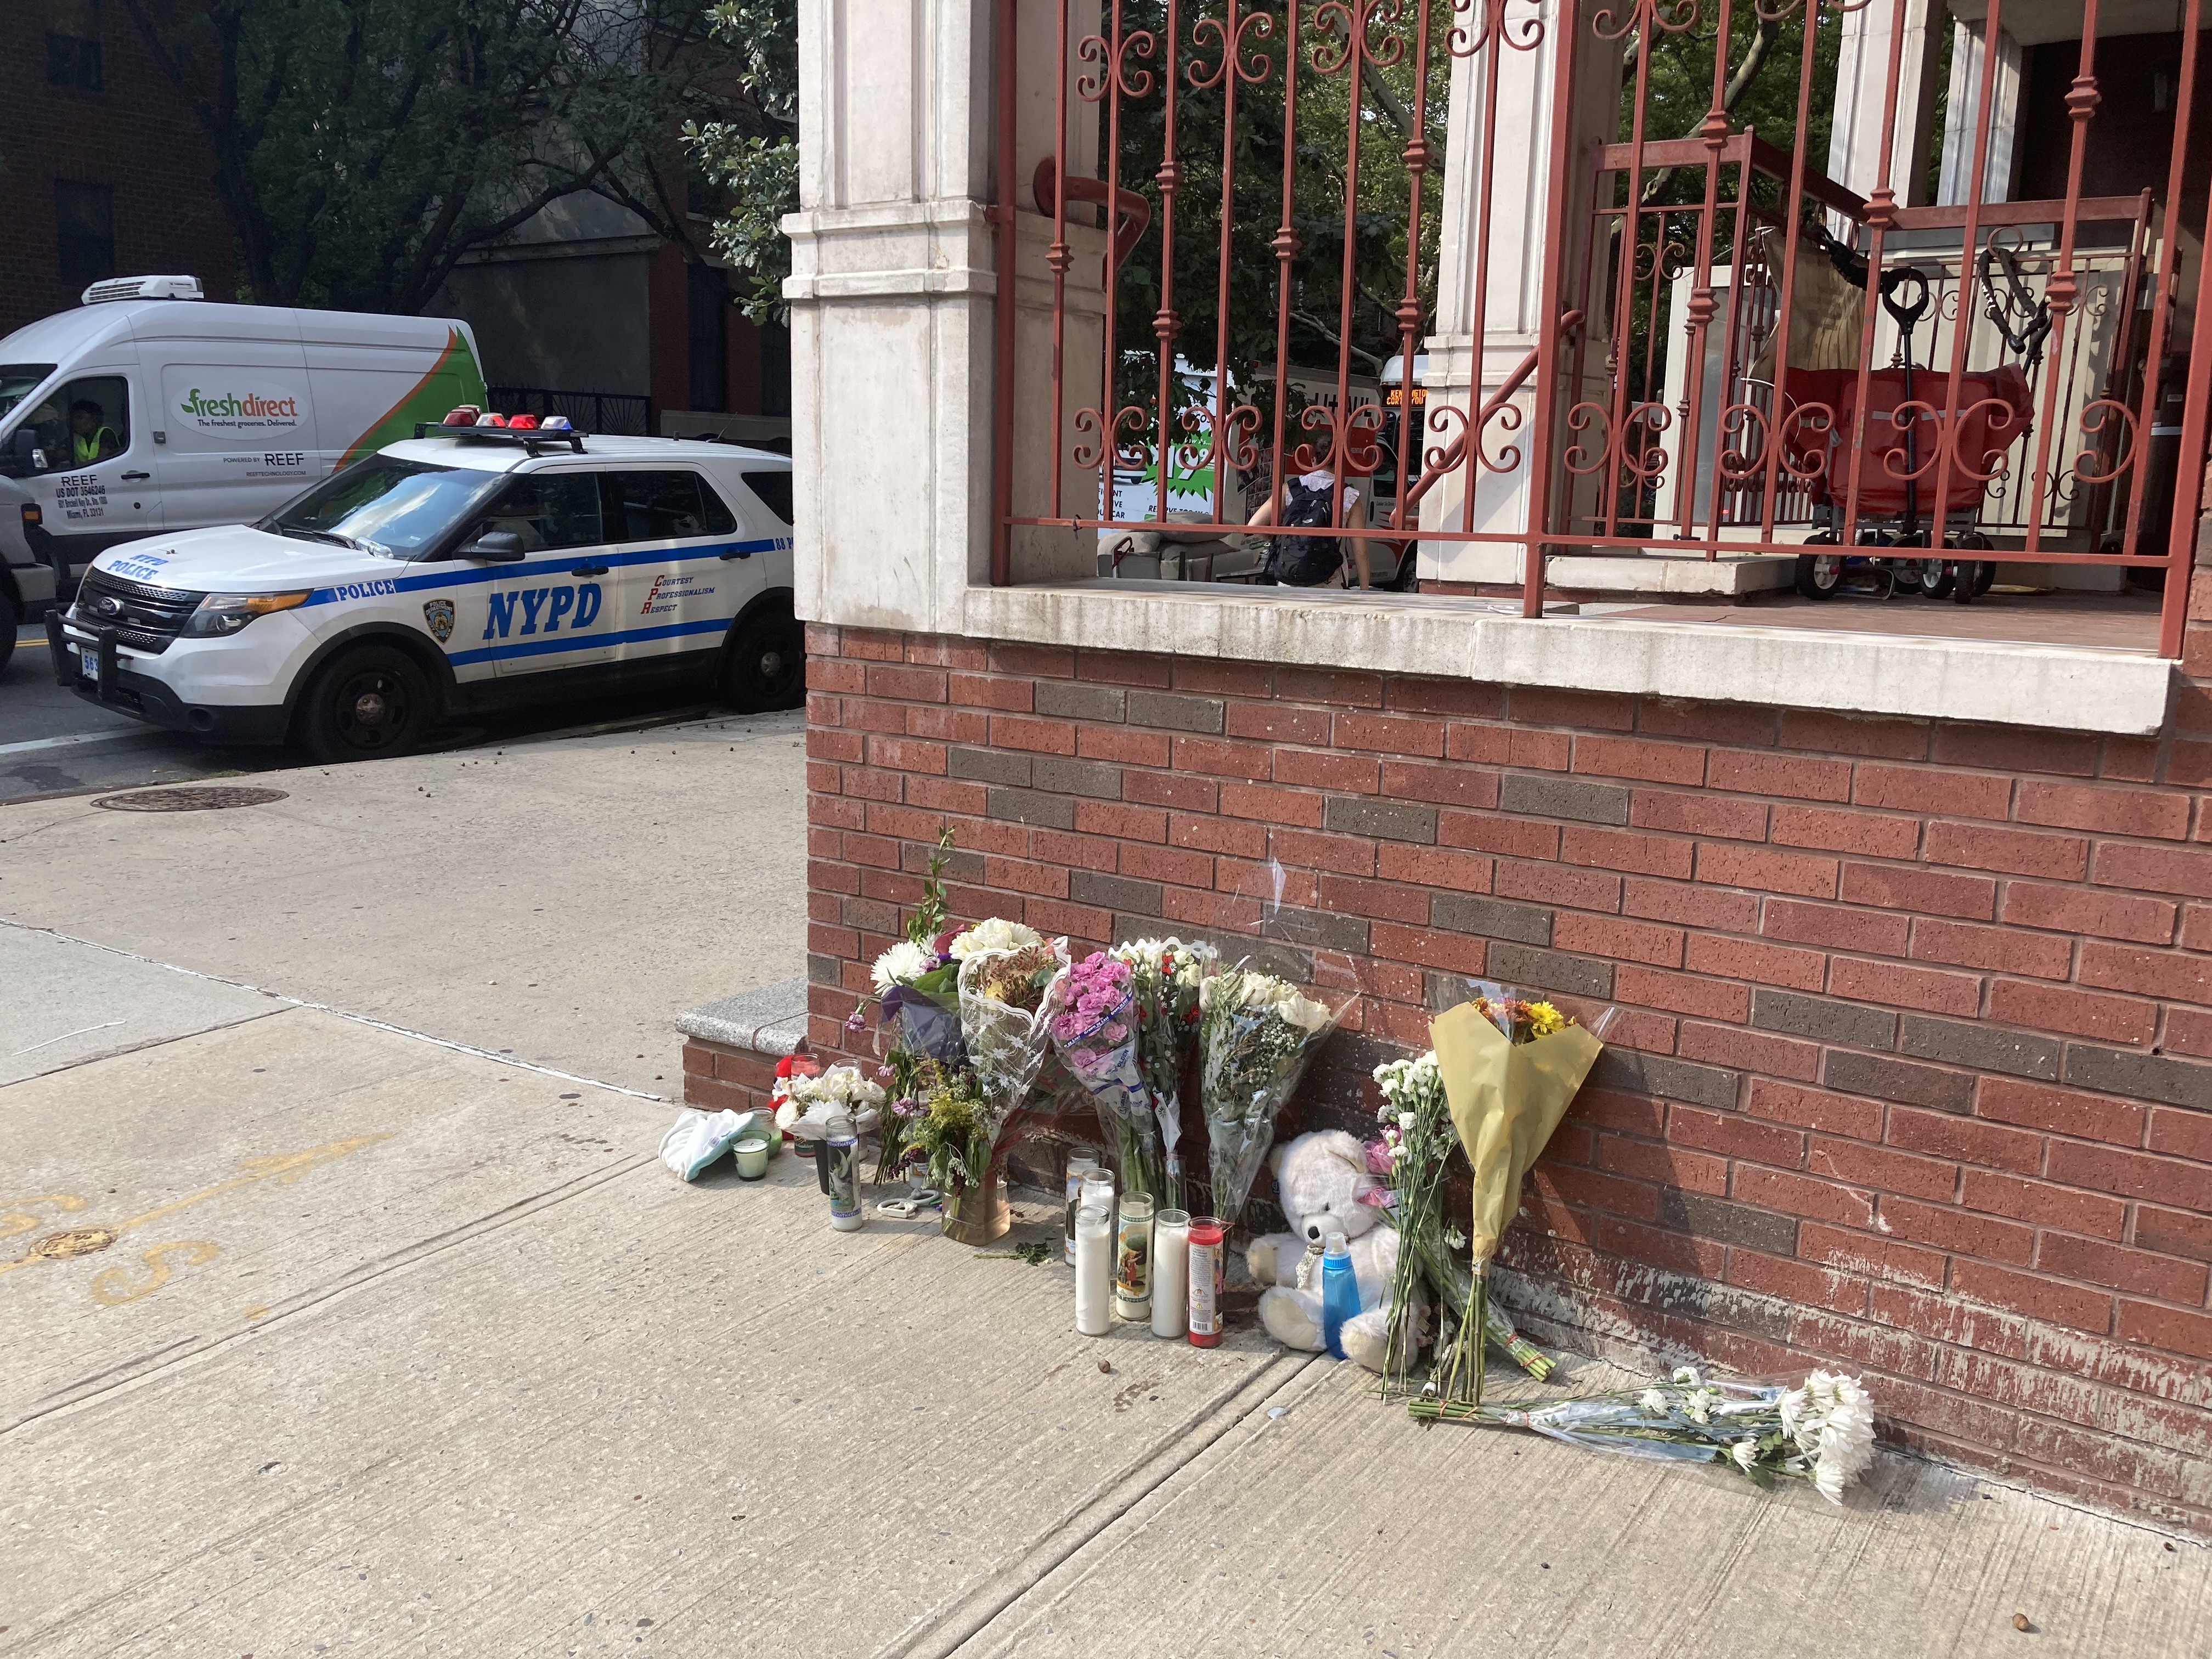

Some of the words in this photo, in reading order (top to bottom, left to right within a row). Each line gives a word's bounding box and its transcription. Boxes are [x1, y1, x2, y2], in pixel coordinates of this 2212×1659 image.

[189, 388, 298, 417] freshdirect
[238, 420, 266, 428] groceries.
[264, 453, 304, 466] REEF
[61, 475, 97, 487] REEF
[55, 488, 65, 498] US
[66, 487, 78, 497] DOT
[81, 485, 105, 496] 3546246
[776, 538, 786, 550] 88
[787, 537, 793, 549] P
[129, 554, 169, 566] NYPD
[107, 560, 159, 580] POLICE
[336, 579, 394, 601] POLICE
[482, 583, 602, 640] NYPD
[1117, 1049, 1129, 1068] OLDEN
